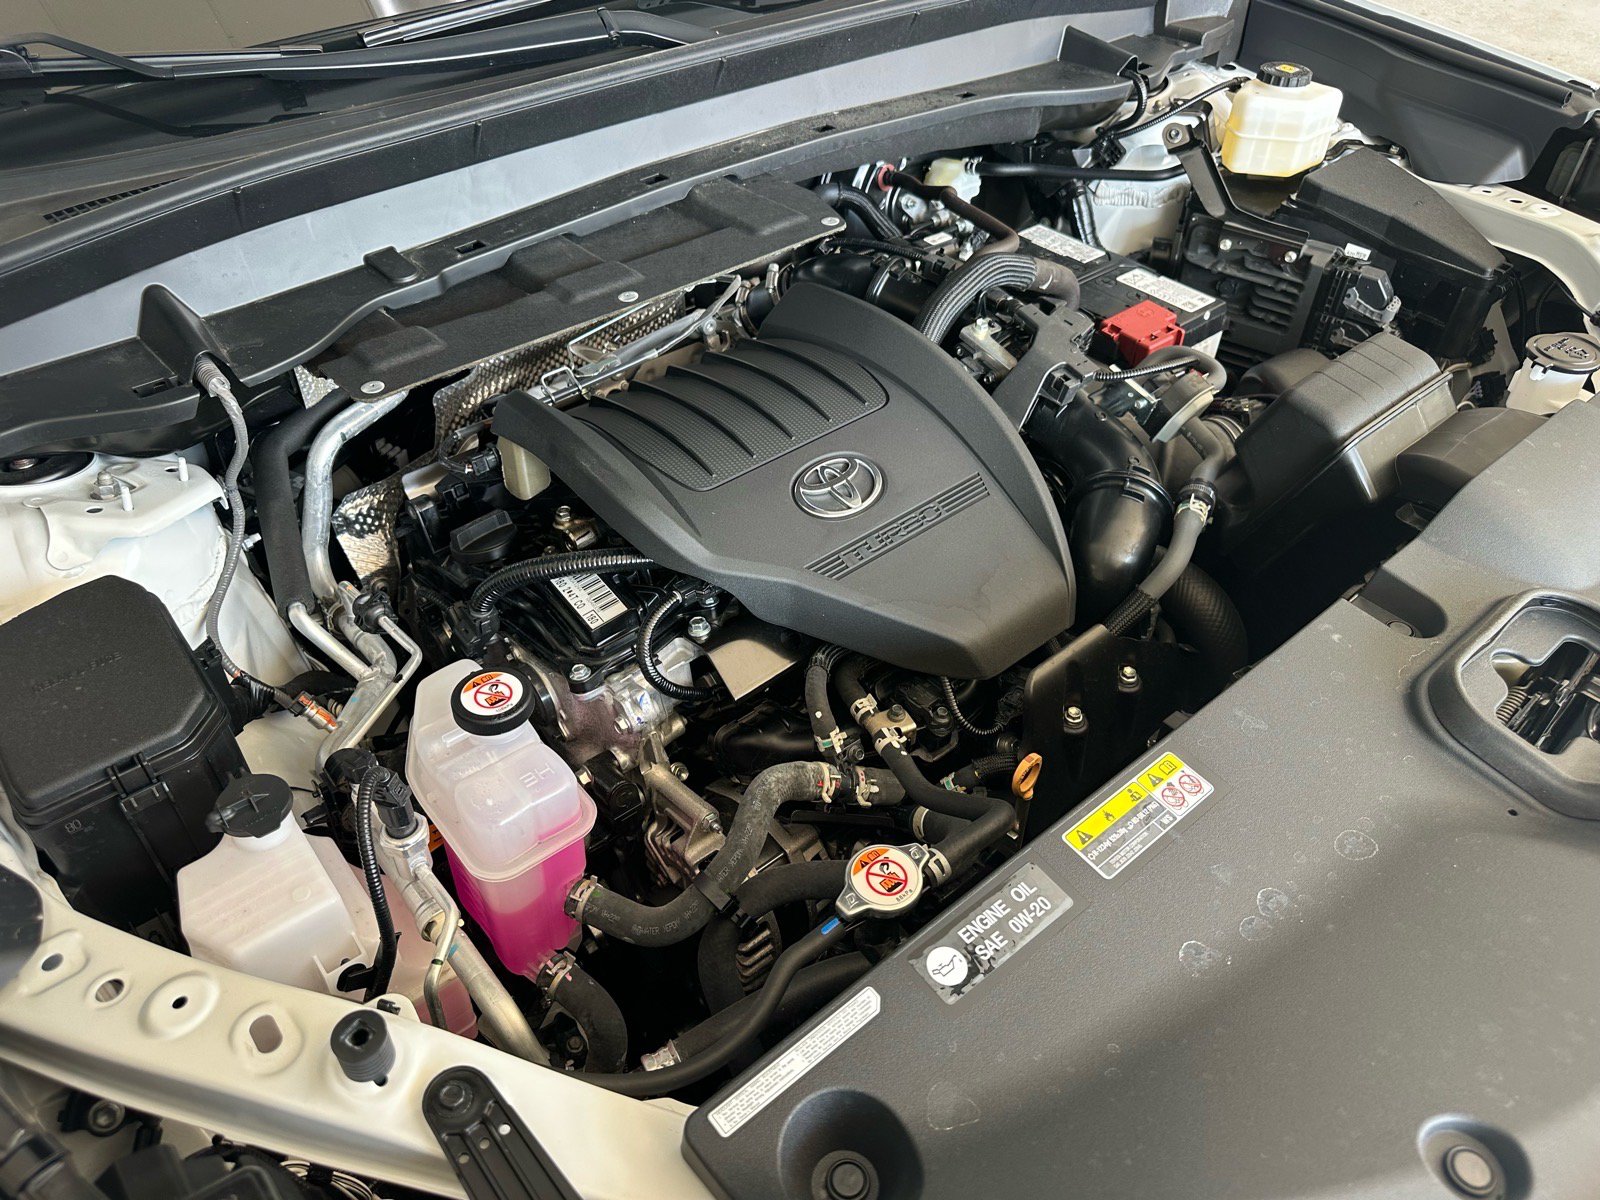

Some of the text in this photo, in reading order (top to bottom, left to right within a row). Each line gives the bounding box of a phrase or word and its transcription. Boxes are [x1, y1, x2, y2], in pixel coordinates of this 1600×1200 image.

[841, 504, 942, 561] TURBO
[957, 881, 1038, 944] ENGINE OIL
[974, 896, 1052, 961] SAE 0W-20
